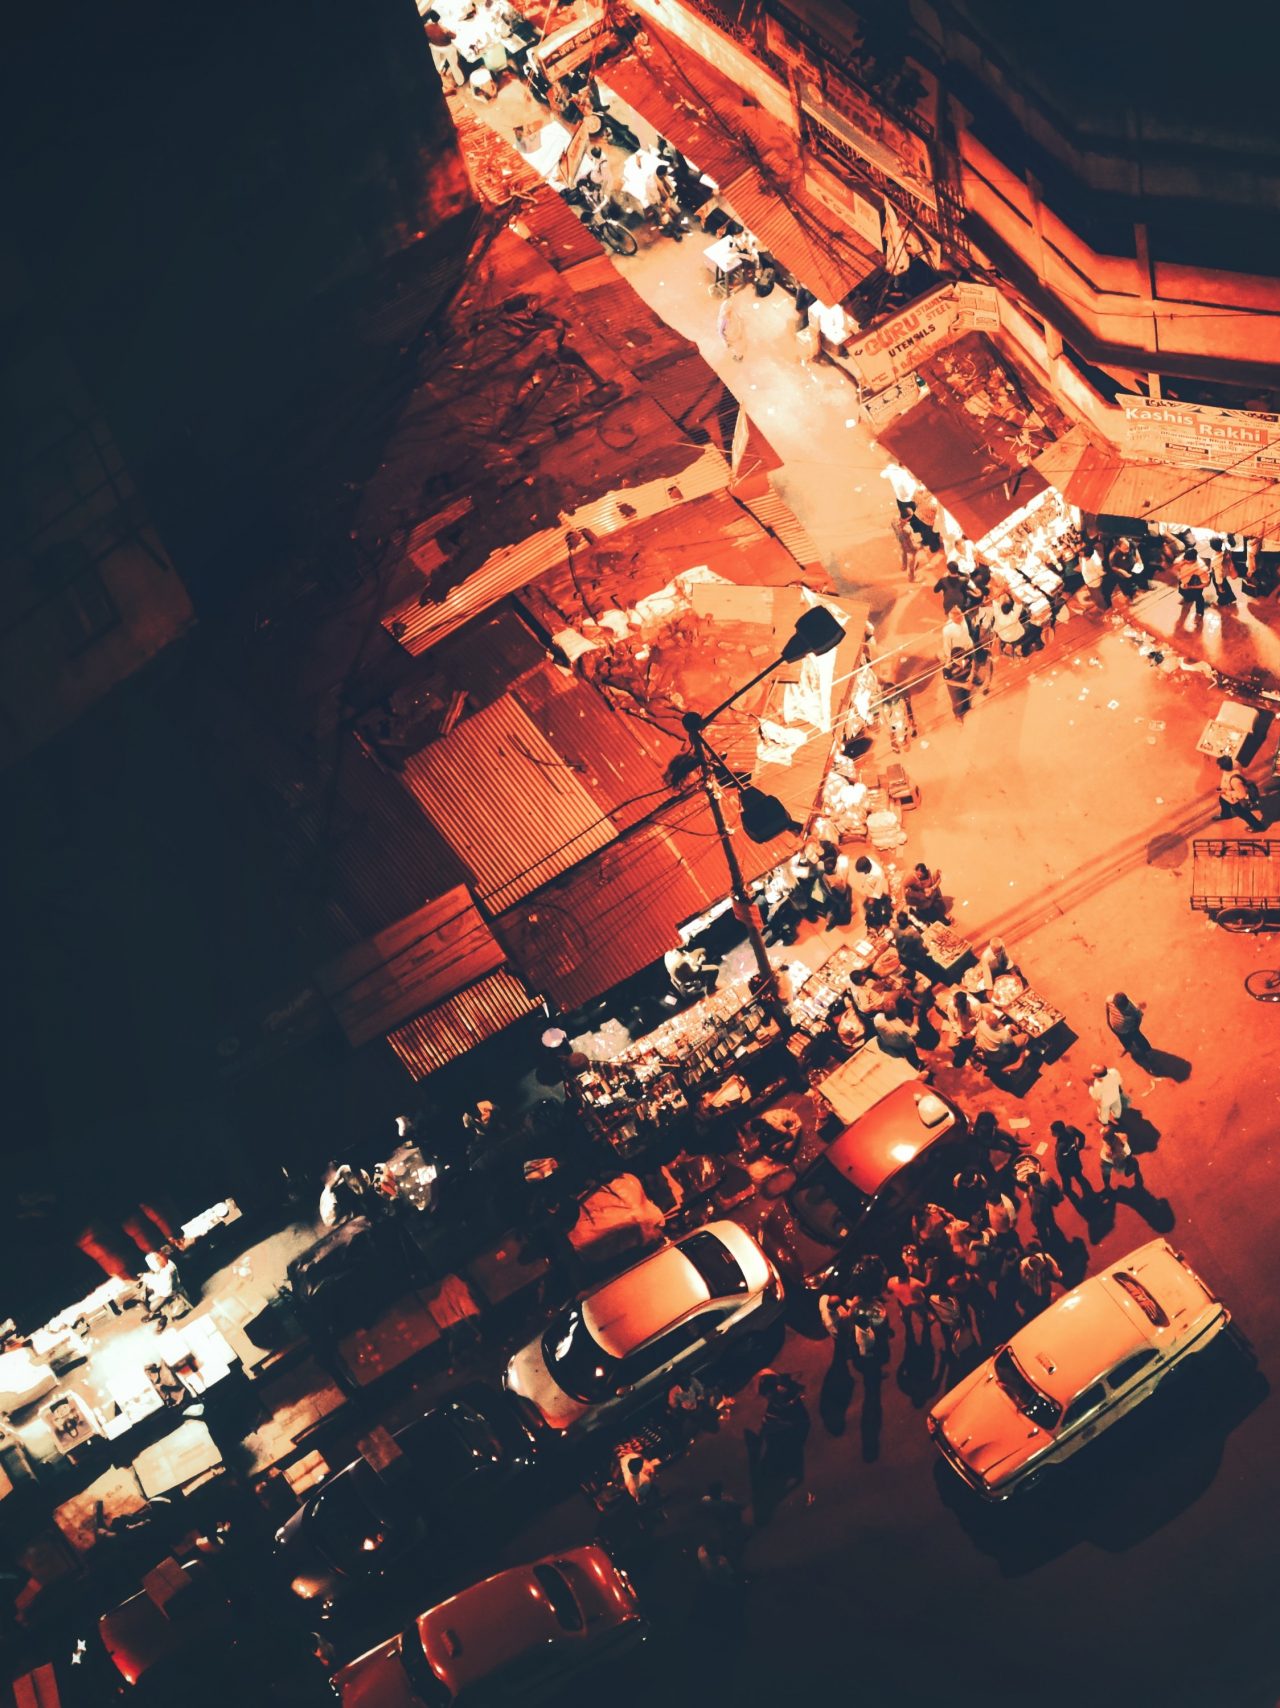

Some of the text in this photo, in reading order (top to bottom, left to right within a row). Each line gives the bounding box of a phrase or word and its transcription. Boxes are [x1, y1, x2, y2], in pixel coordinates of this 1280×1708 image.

[925, 302, 951, 320] STEEL
[864, 312, 921, 357] GURU
[1125, 406, 1194, 426] Kashis
[1199, 423, 1260, 442] Rakhi
